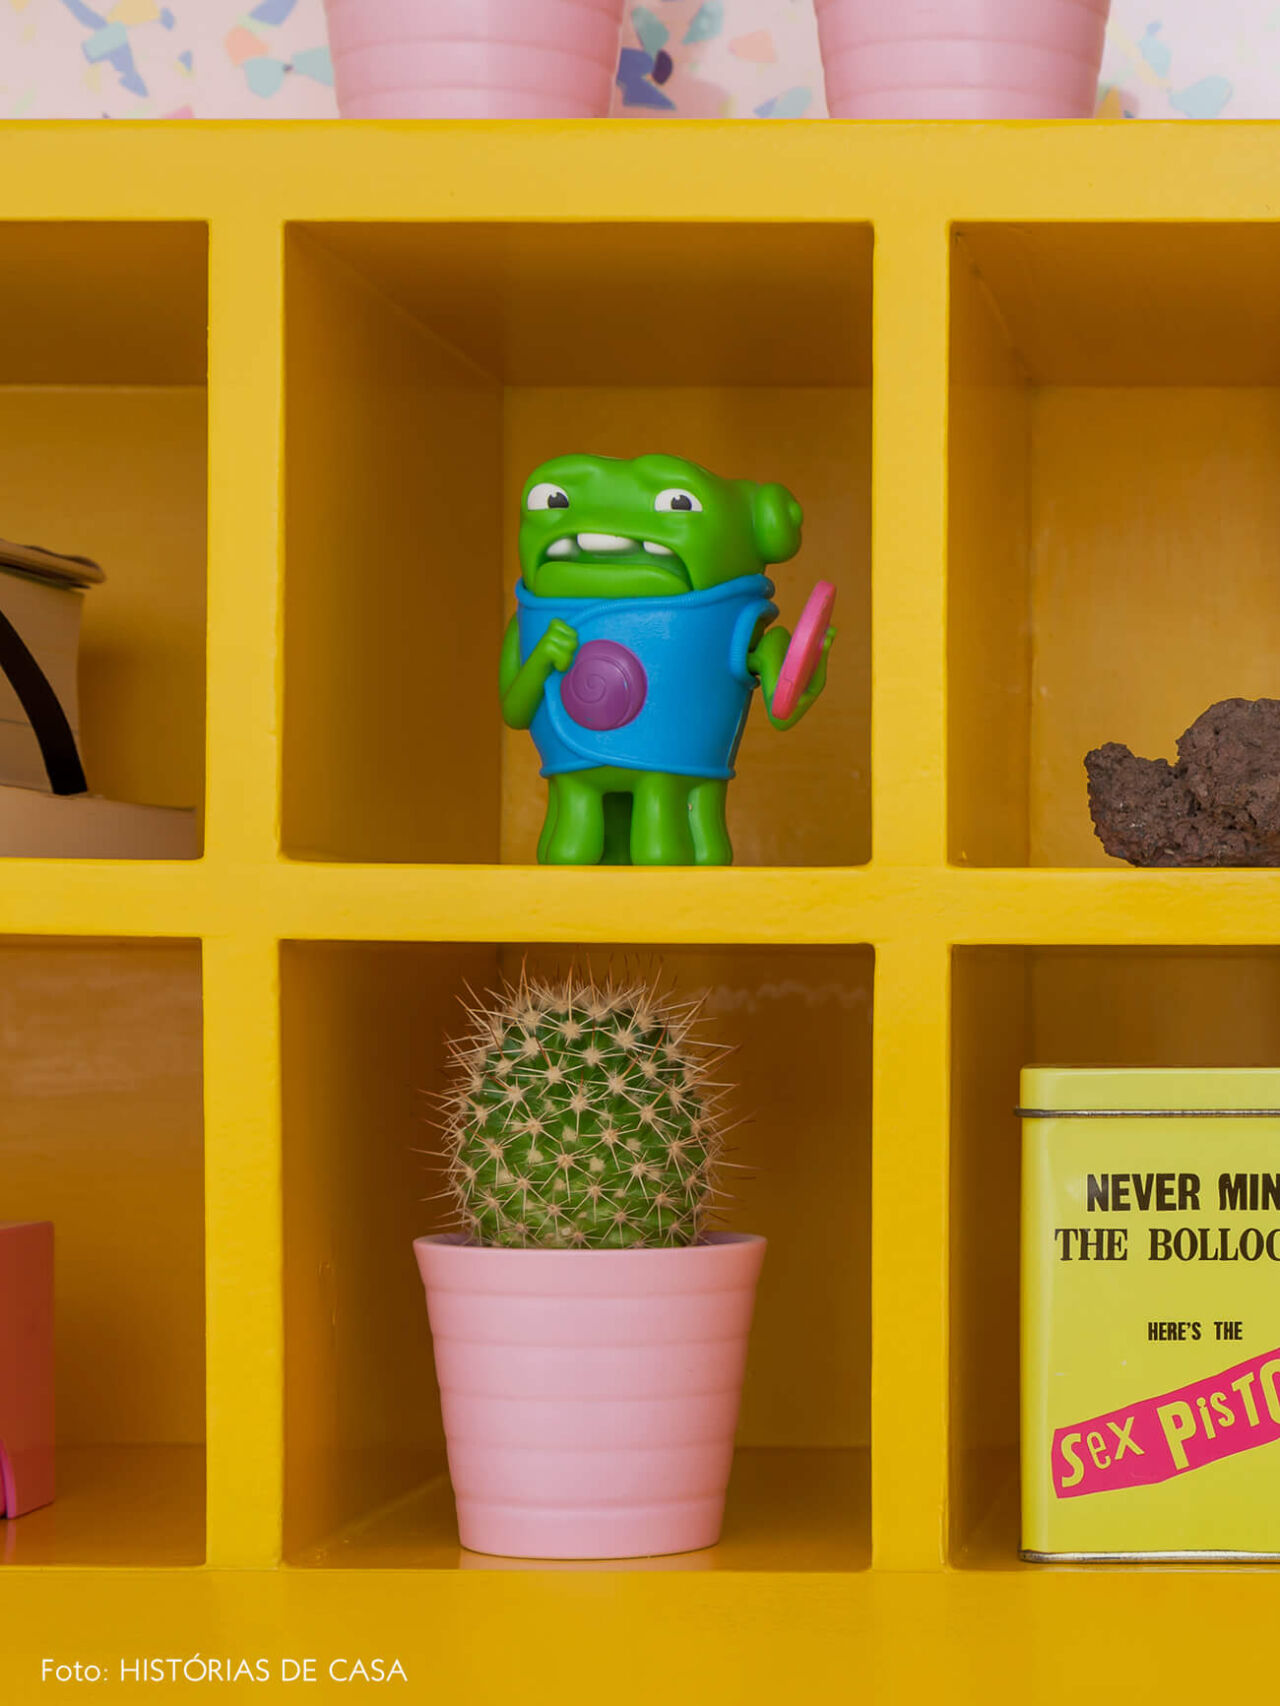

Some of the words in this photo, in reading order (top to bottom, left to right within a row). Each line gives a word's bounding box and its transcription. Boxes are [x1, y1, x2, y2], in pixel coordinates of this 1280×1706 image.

[1086, 1173, 1201, 1212] NEVER
[1055, 1228, 1128, 1261] THE
[1147, 1322, 1202, 1341] HERE'S
[1214, 1321, 1243, 1341] THE
